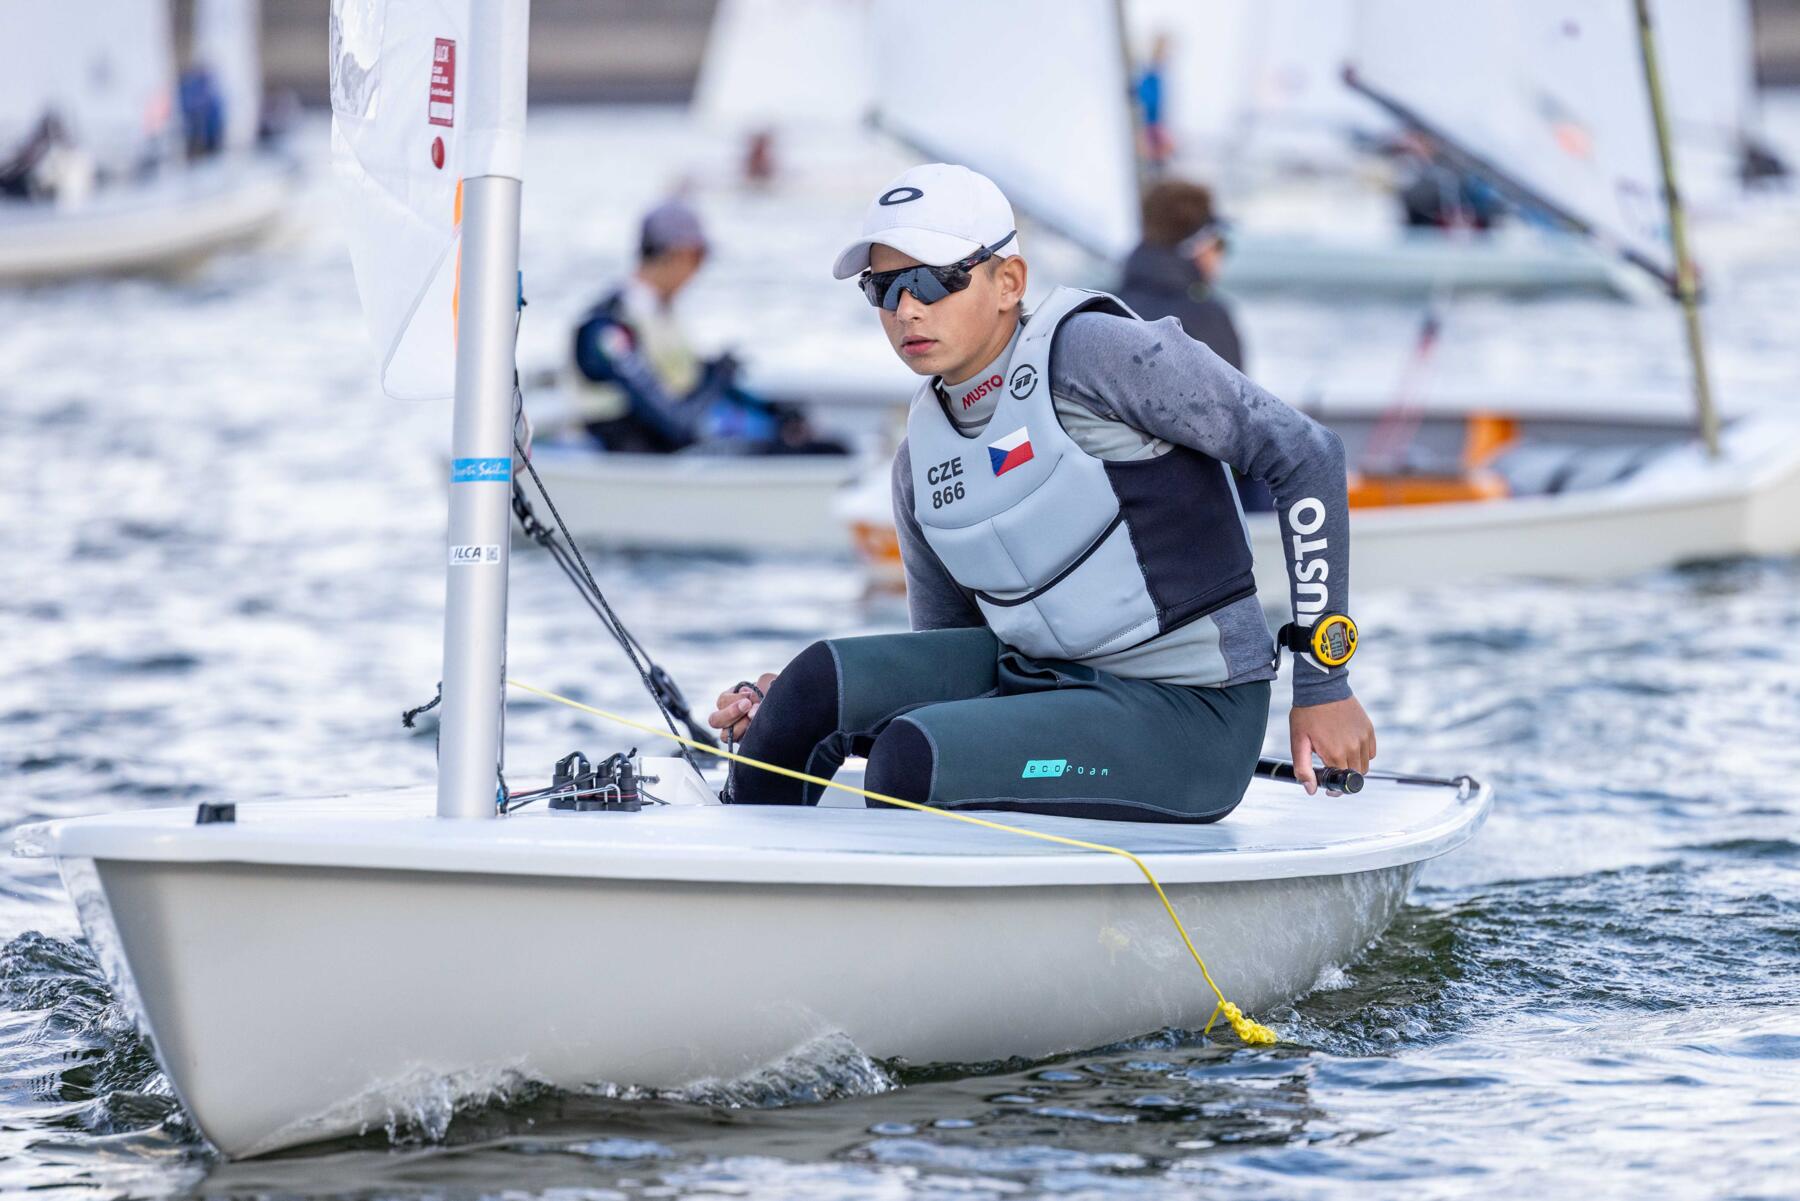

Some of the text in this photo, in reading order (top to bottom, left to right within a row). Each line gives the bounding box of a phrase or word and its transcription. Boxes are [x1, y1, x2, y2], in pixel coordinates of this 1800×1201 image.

[961, 374, 1004, 410] MUSTO
[927, 456, 964, 486] CZE
[932, 481, 966, 510] 866
[454, 546, 481, 559] ILCA
